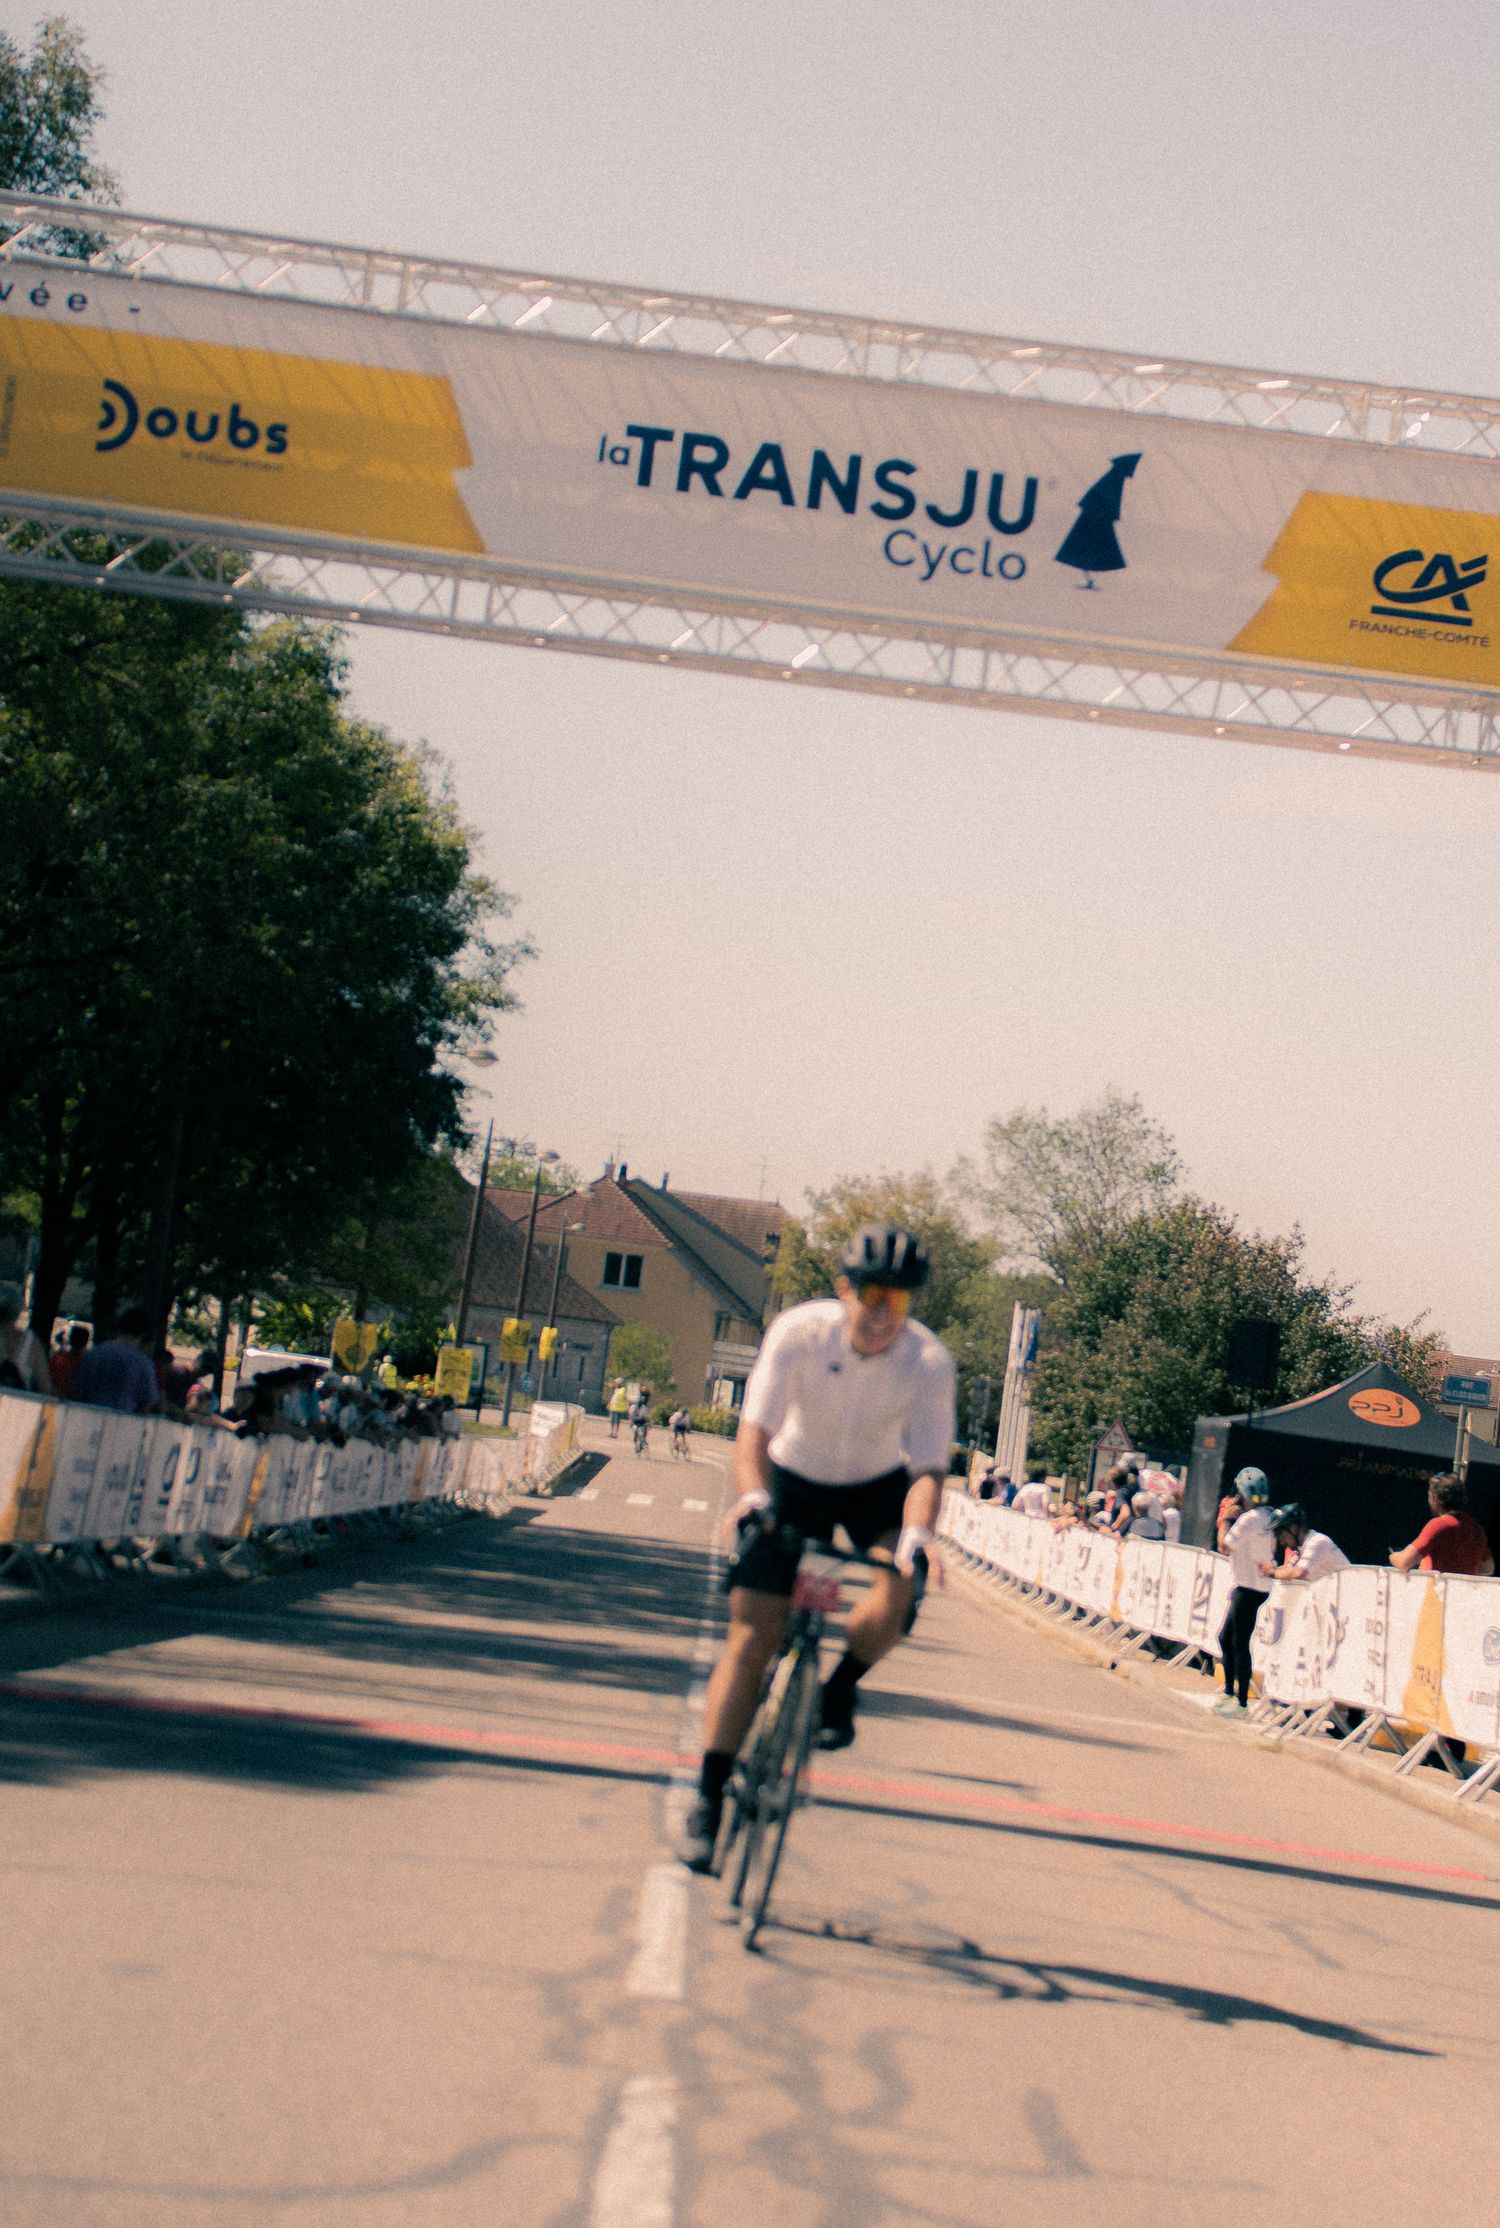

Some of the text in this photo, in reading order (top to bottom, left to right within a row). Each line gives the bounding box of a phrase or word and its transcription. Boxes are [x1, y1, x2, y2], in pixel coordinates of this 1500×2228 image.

[599, 424, 1038, 535] la TRANSJU
[883, 529, 1026, 581] Cyclo
[1349, 619, 1490, 648] FRANCHE-COMTÉ
